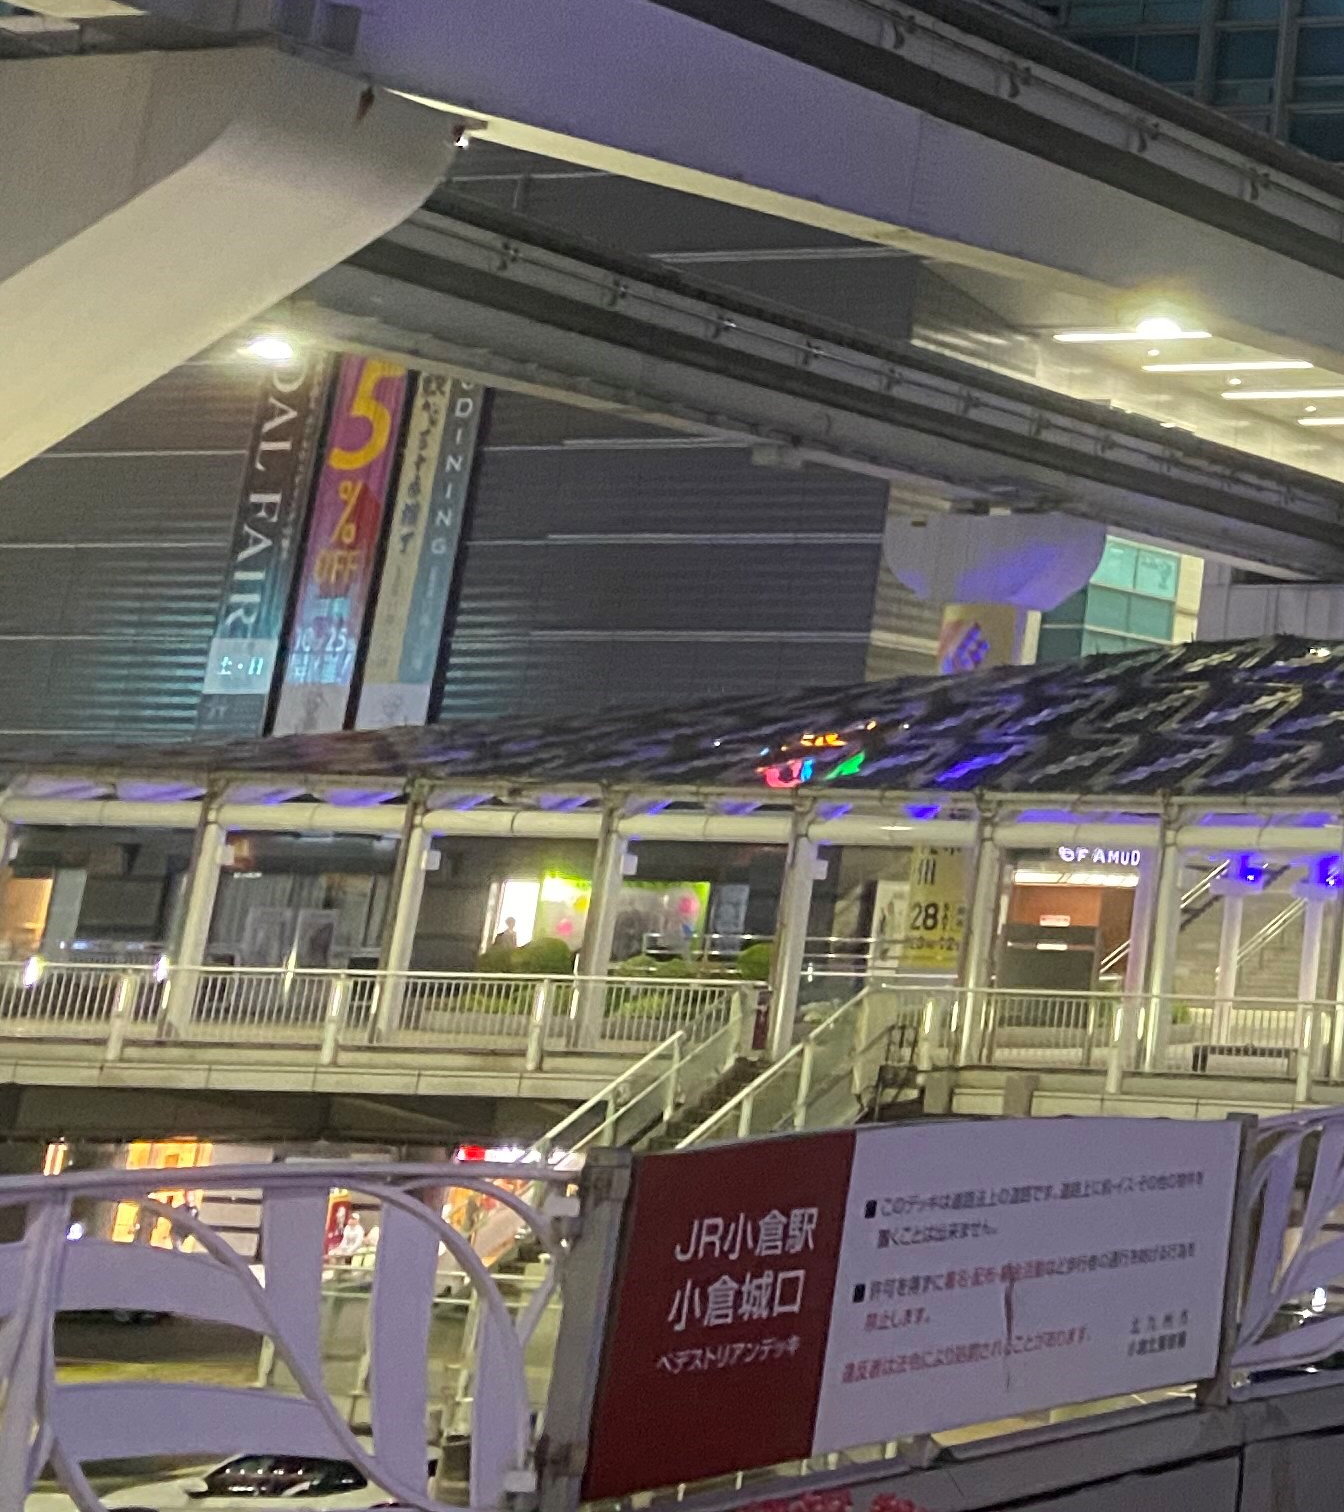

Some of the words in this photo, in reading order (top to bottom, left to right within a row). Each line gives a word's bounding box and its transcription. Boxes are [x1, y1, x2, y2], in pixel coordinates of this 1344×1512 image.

[224, 491, 282, 636] FAIR
[674, 1207, 819, 1261] JR小倉駅
[667, 1269, 806, 1332] 小倉城口
